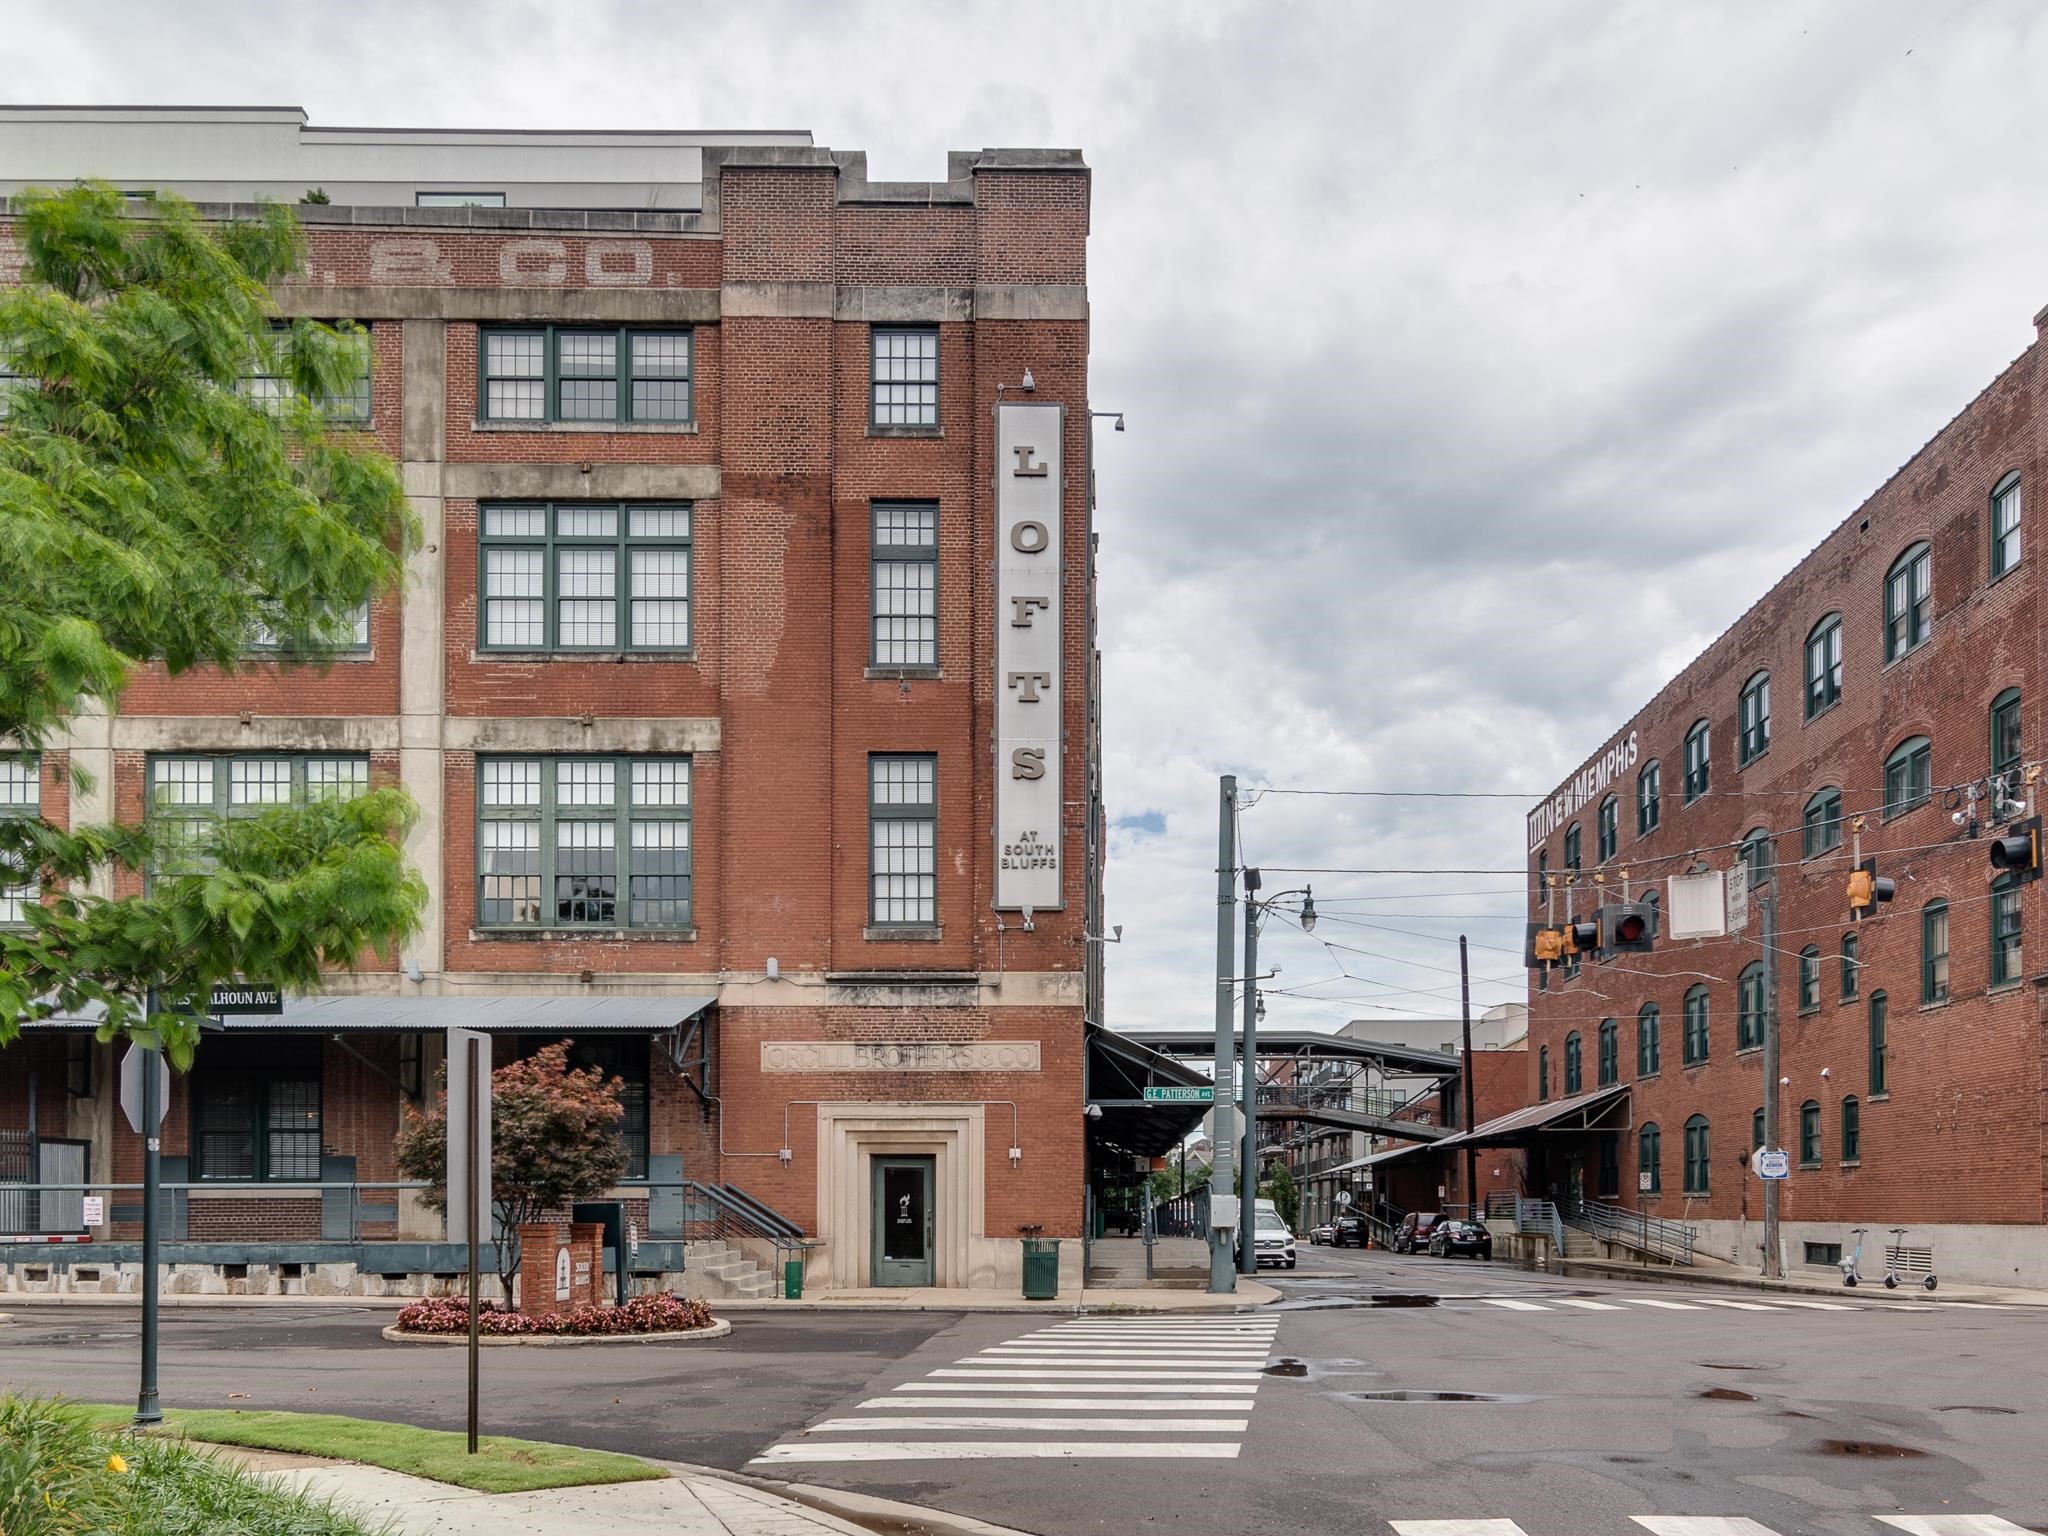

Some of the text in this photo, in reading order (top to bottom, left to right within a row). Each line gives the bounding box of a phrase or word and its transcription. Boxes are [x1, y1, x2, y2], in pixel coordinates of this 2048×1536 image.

[370, 238, 456, 285] &
[1007, 445, 1051, 780] LOFTS
[1020, 830, 1038, 842] AT
[1004, 844, 1054, 856] SOUTH
[1001, 858, 1056, 869] BLUFFS
[1729, 872, 1744, 890] STOP
[1727, 903, 1747, 922] FLASHING
[208, 991, 252, 1005] ALHOUN
[255, 991, 278, 1004] AVE
[854, 1047, 974, 1069] BROTHERS
[977, 1047, 994, 1068] &
[998, 1047, 1033, 1068] CO
[1161, 1089, 1200, 1099] PATTERSON
